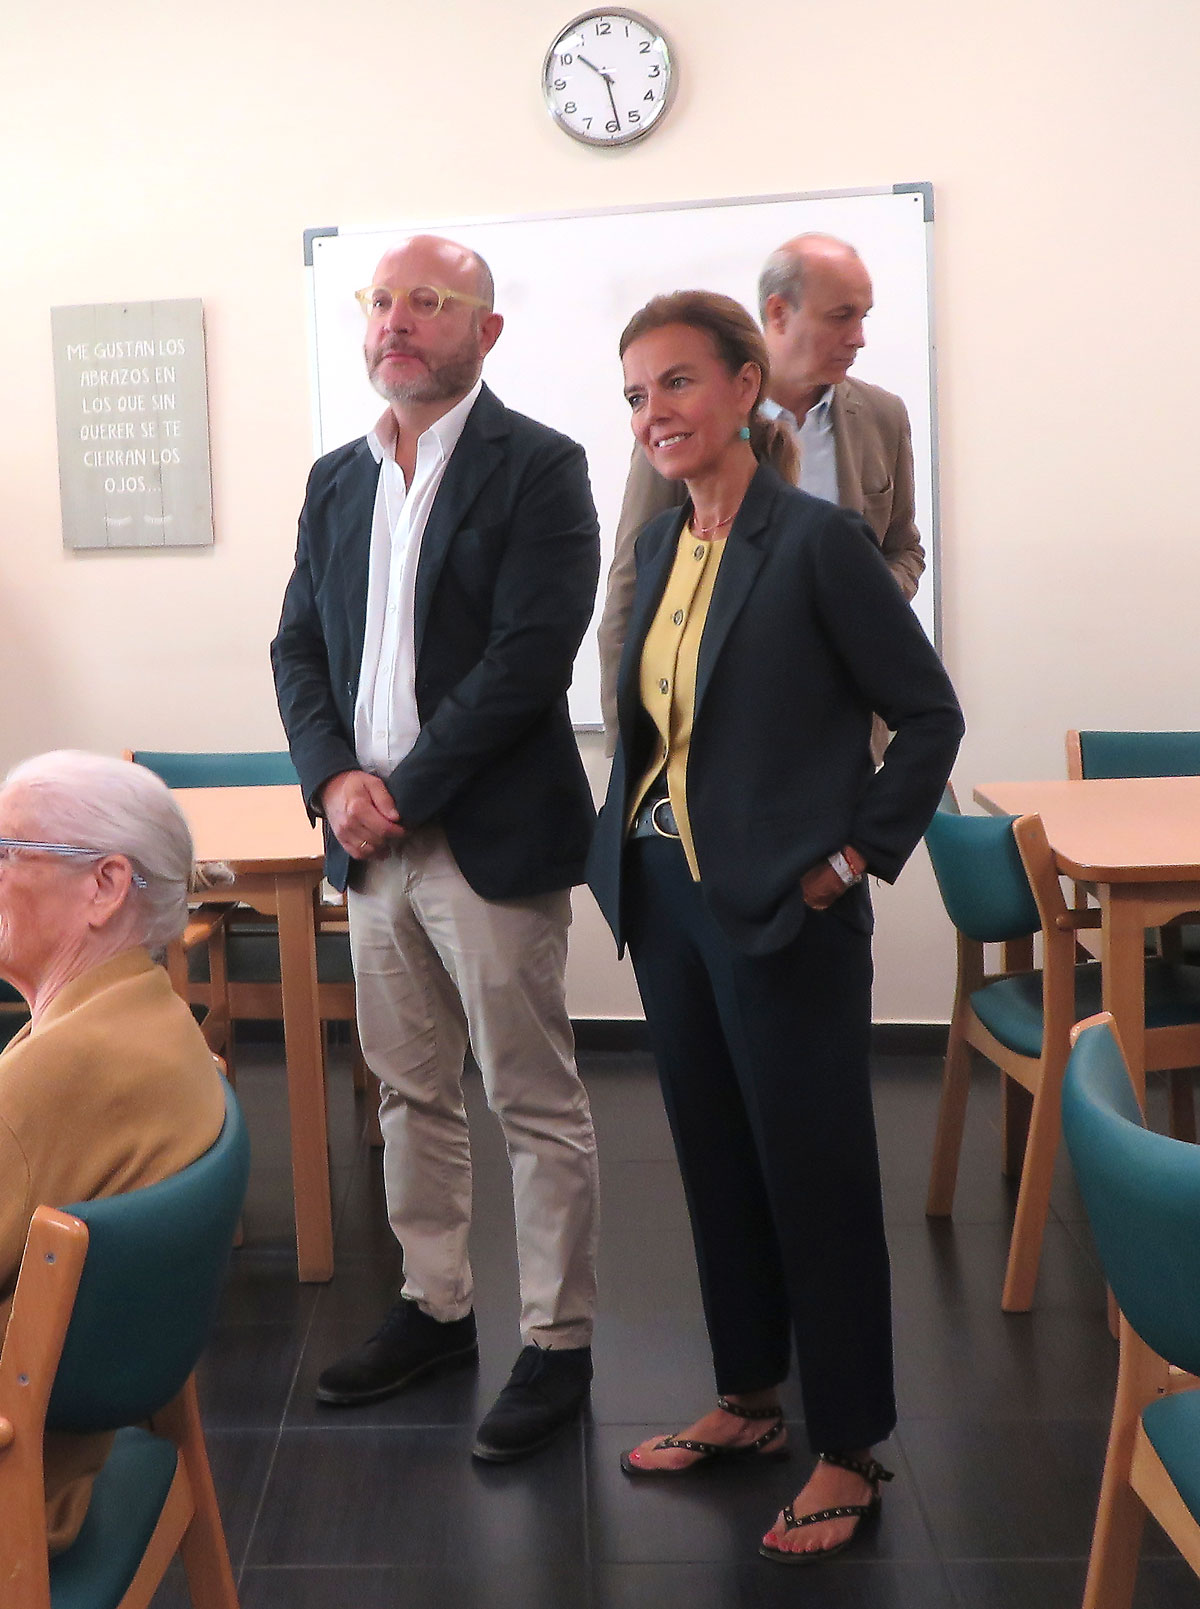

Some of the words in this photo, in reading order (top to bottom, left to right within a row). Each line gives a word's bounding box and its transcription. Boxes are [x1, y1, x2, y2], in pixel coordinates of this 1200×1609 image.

[596, 23, 611, 36] 12
[639, 41, 650, 54] 2
[560, 53, 573, 66] 10
[648, 65, 660, 78] 3
[554, 79, 567, 91] 9
[643, 89, 655, 102] 4
[564, 101, 577, 114] 8
[628, 110, 640, 123] 5
[582, 117, 593, 130] 7
[605, 121, 618, 133] 6
[66, 344, 90, 360] ME
[94, 340, 155, 359] GUSTAN
[159, 338, 185, 356] LOS
[80, 367, 151, 388] ABRAZOS
[155, 366, 176, 384] EN
[82, 397, 112, 414] LOS
[117, 395, 146, 412] QUE
[152, 393, 175, 411] SIN
[80, 422, 135, 441] QUERER
[140, 421, 155, 438] SE
[163, 420, 181, 437] TE
[83, 448, 146, 467] CIERRAN
[151, 447, 180, 465] LOS
